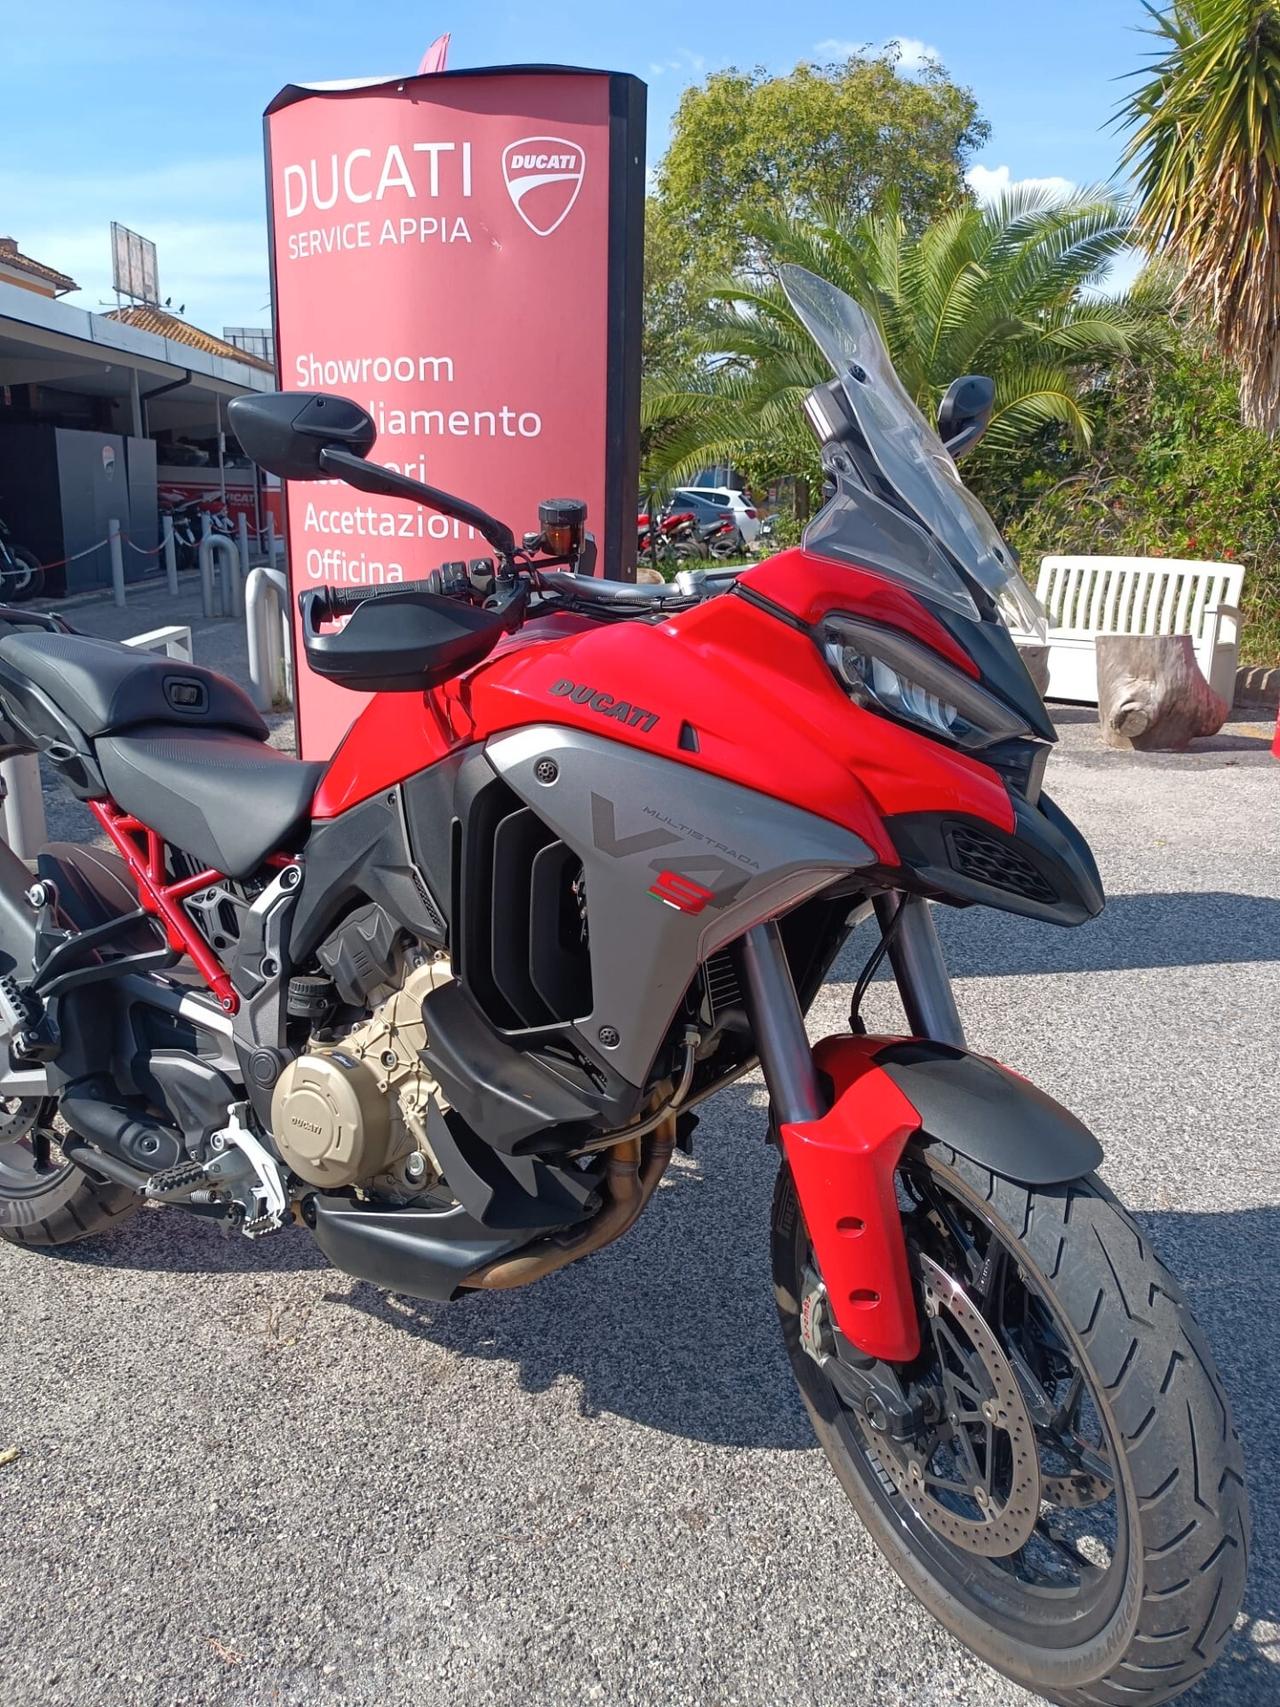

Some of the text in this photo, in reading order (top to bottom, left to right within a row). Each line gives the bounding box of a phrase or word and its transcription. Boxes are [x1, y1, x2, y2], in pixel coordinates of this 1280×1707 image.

[284, 142, 471, 218] DUCATI
[511, 154, 576, 169] DUCATI
[288, 217, 472, 260] SERVICE APPIA
[295, 352, 454, 387] Showroom
[304, 502, 487, 540] Accettazion
[307, 549, 404, 584] Officina
[549, 678, 660, 733] DUCATI
[642, 806, 761, 870] MULTISTRADA
[291, 1116, 323, 1135] DUCATI
